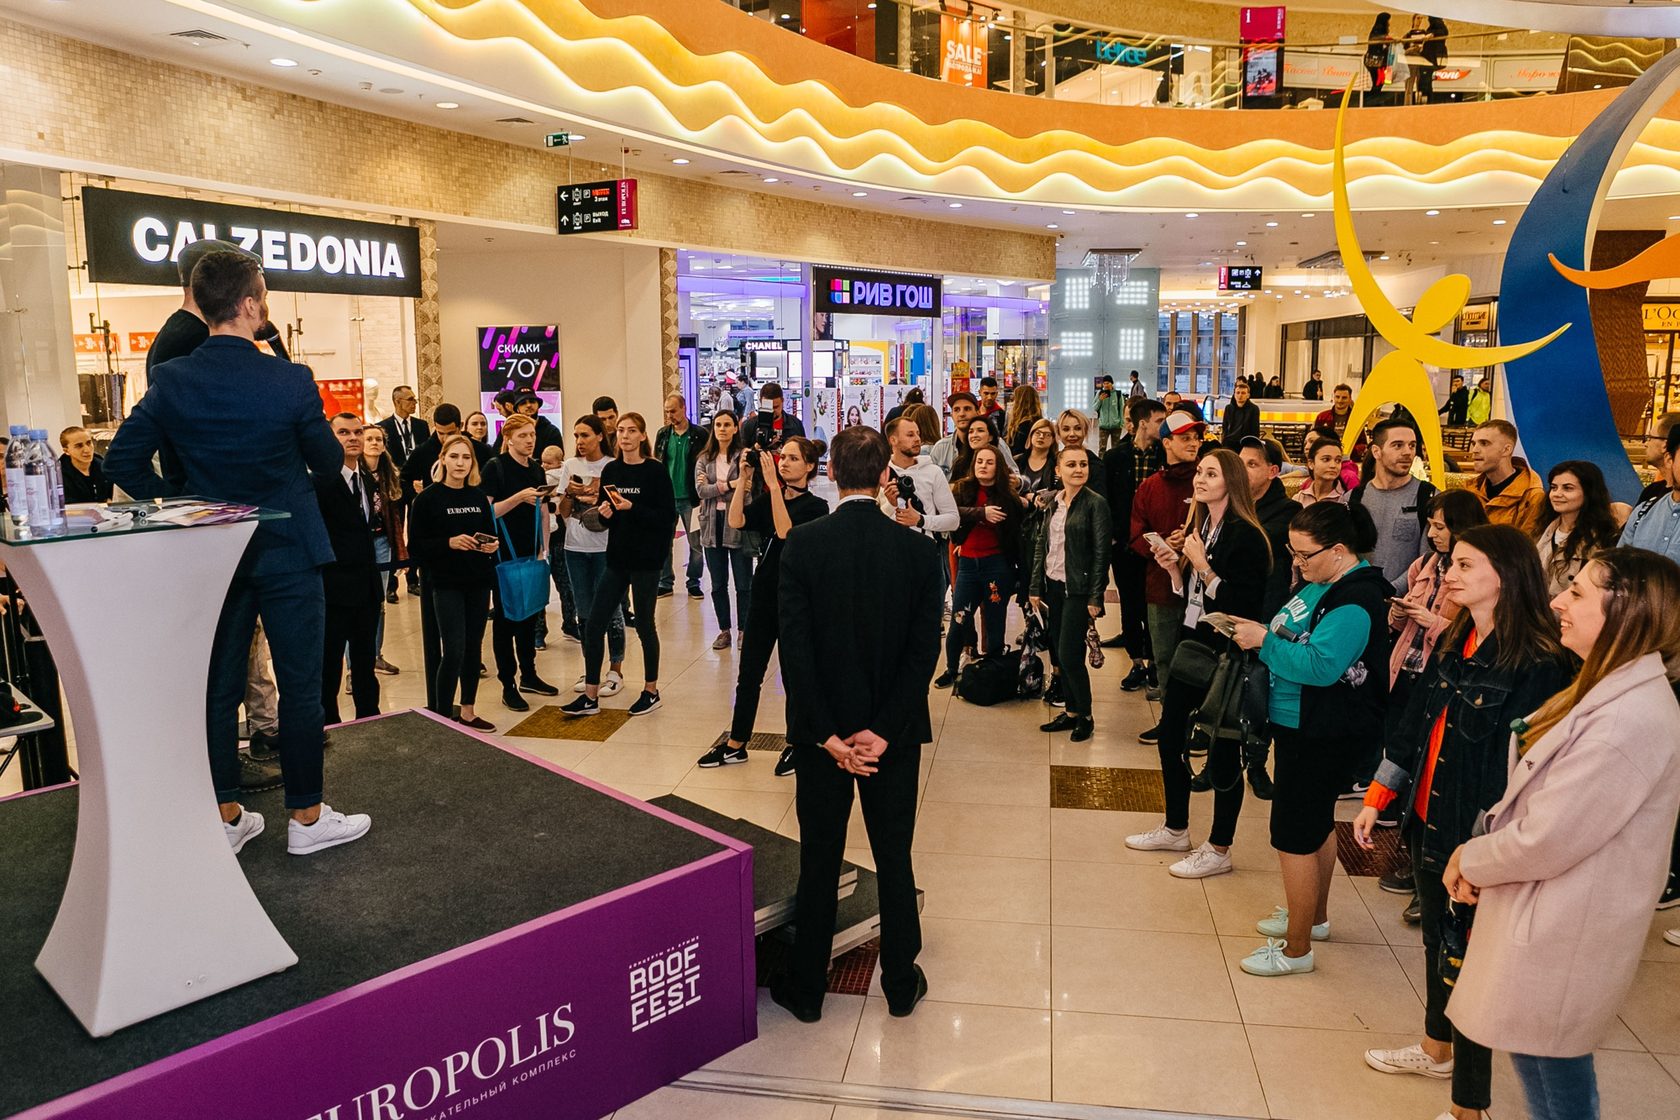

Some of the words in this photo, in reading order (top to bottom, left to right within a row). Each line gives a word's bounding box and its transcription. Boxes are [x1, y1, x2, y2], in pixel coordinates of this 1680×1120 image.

[946, 40, 982, 65] SALE
[853, 281, 893, 307] РИВ
[896, 283, 933, 309] ГОШ
[497, 343, 540, 354] СКИДКИ
[745, 342, 782, 350] CHANEL
[629, 942, 700, 994] ROOF
[631, 973, 701, 1026] FEST
[424, 1080, 507, 1120] КАТЕЛЬНЫЙ
[511, 1049, 577, 1085] КОМПЛЕКС
